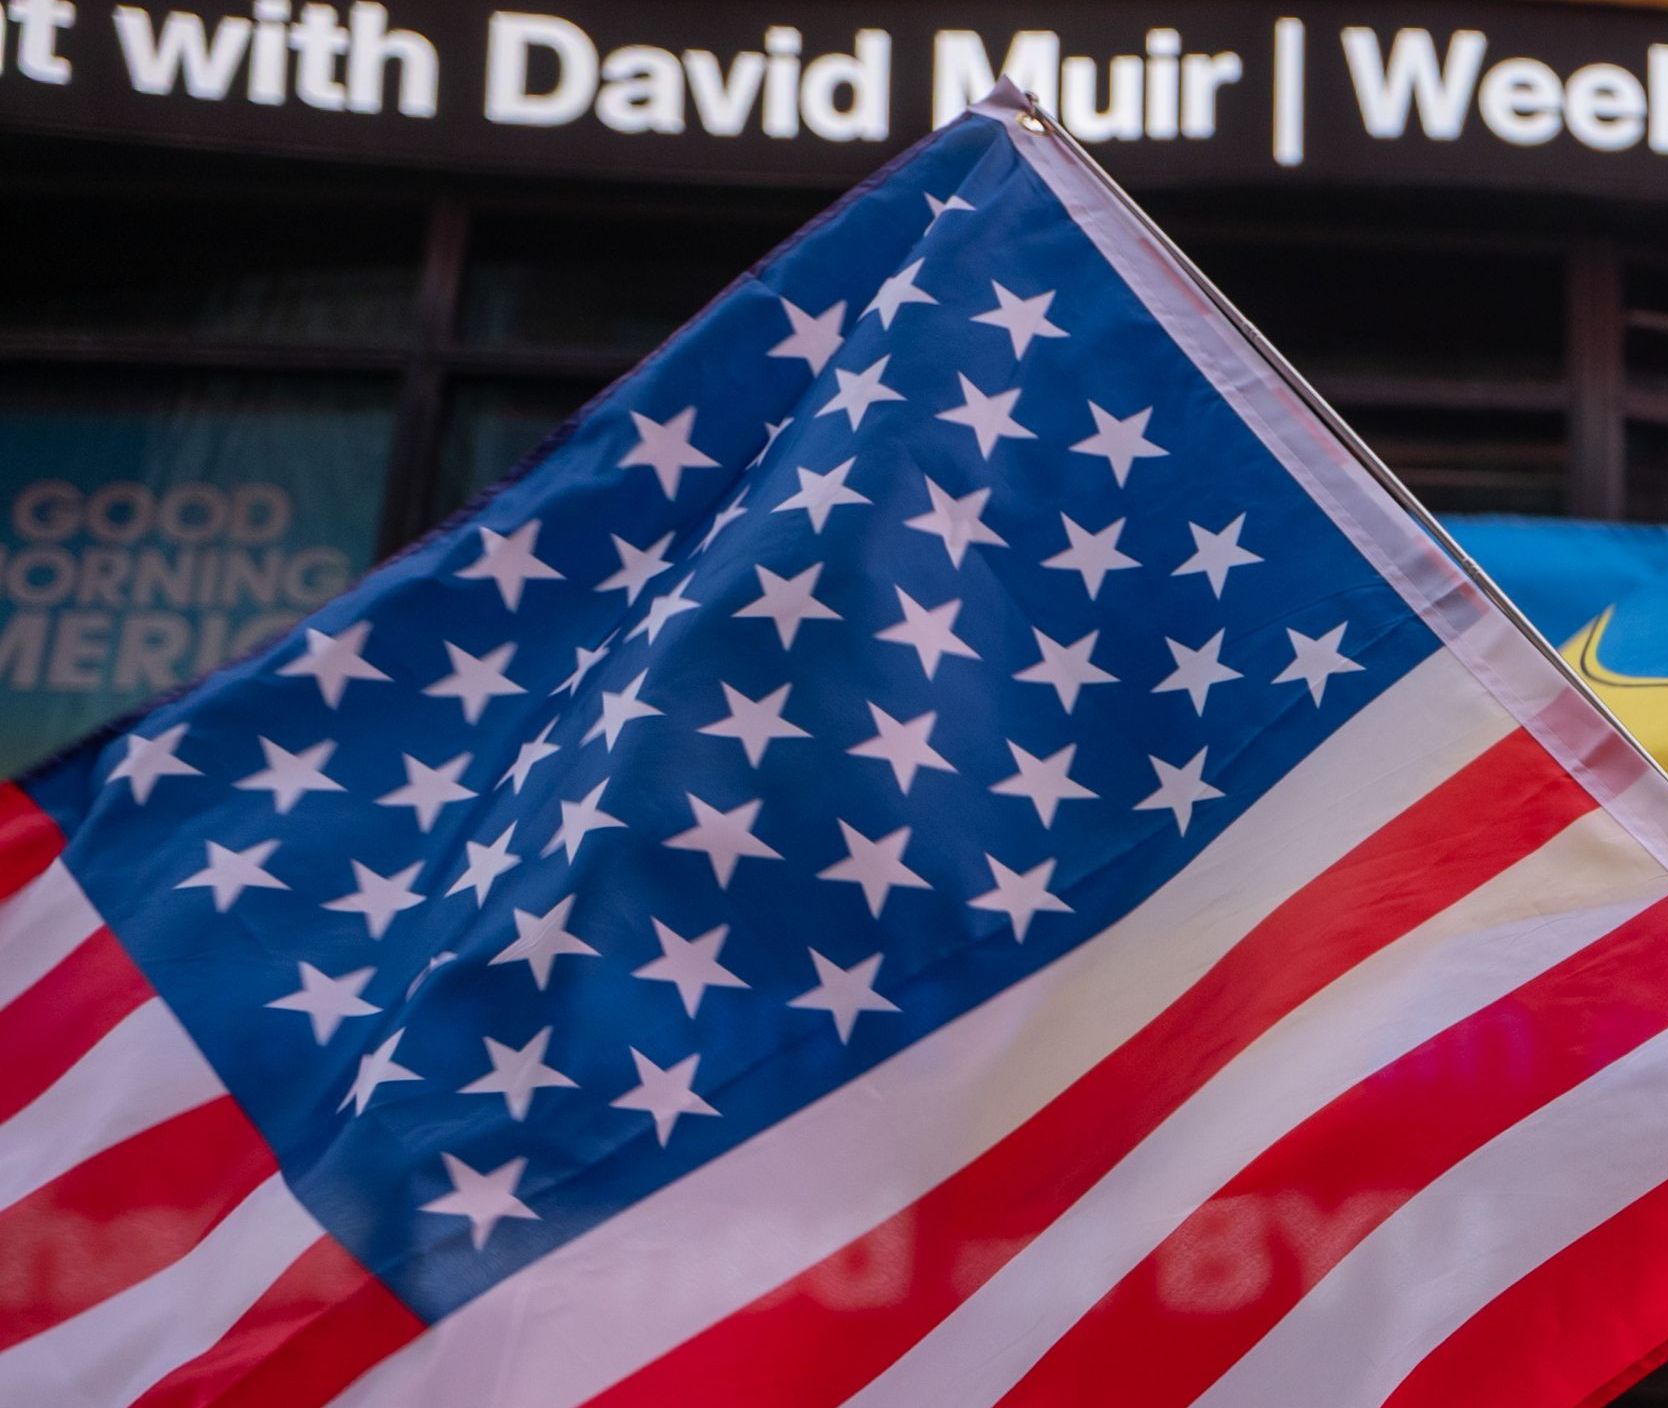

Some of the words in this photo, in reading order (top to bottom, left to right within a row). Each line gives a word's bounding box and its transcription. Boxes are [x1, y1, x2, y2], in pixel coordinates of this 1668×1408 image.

[113, 0, 439, 118] with
[484, 11, 892, 142] David
[932, 28, 1243, 143] Muir
[12, 479, 294, 543] GOOD
[0, 545, 353, 606] ORNING
